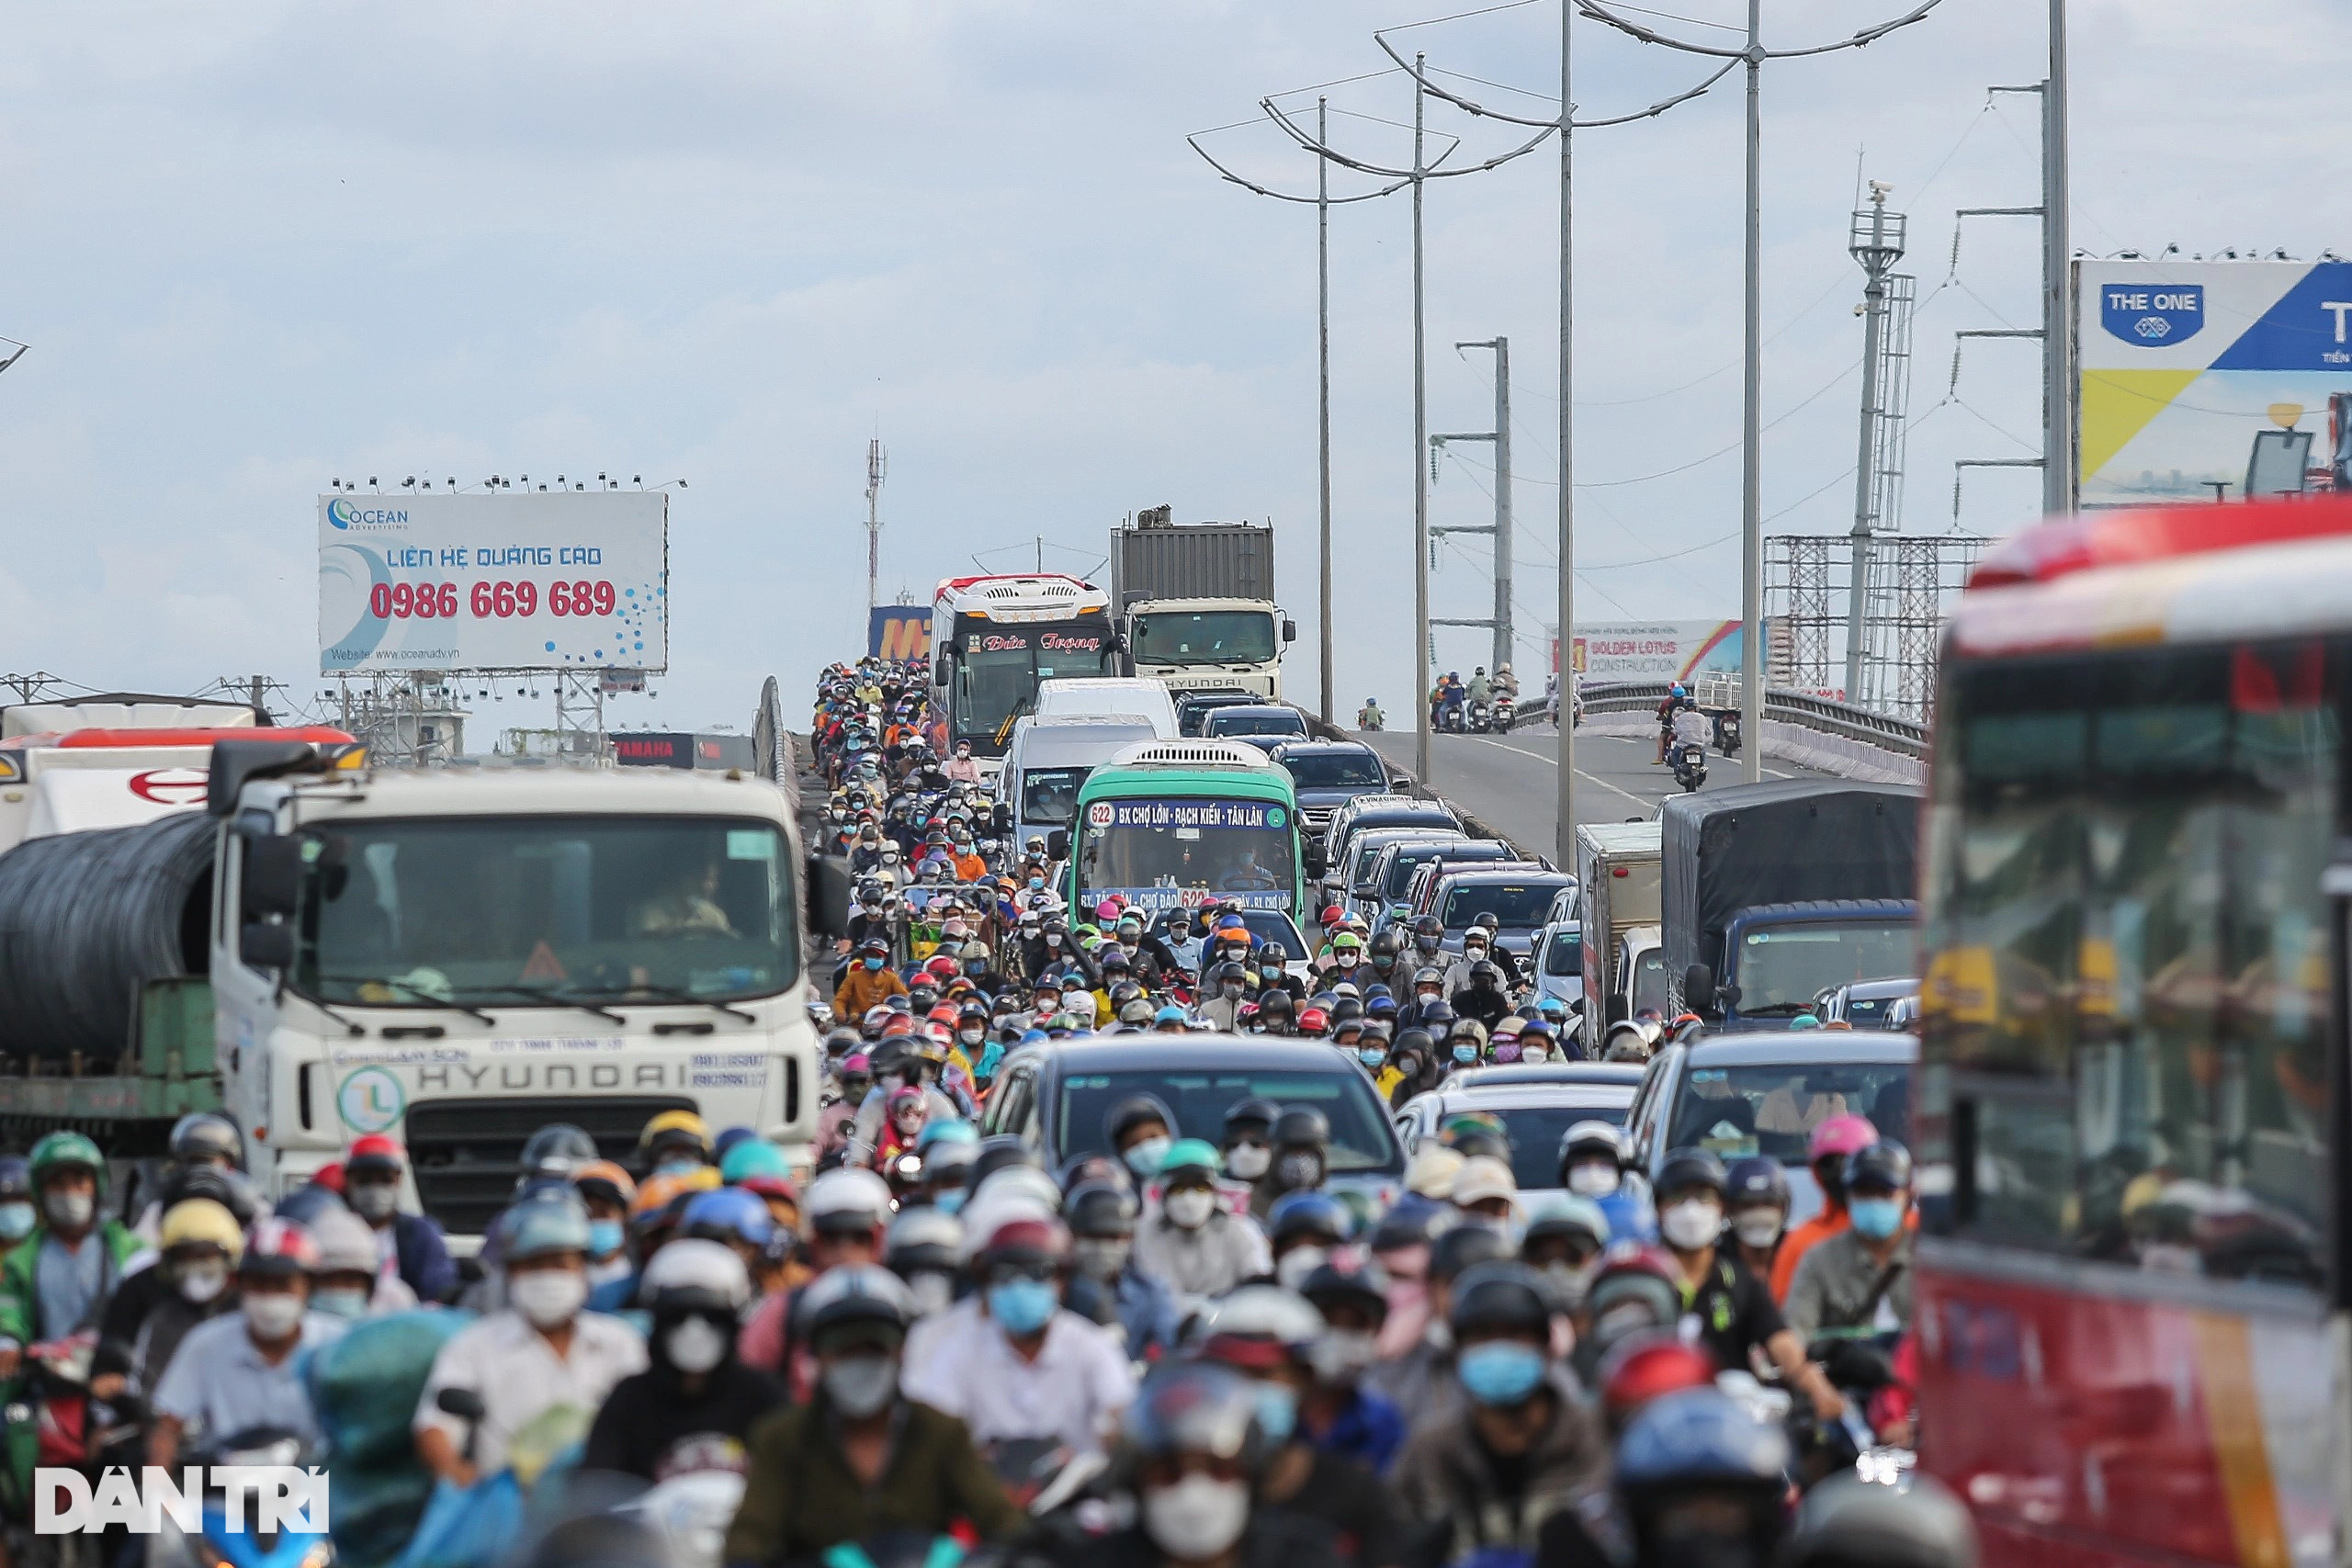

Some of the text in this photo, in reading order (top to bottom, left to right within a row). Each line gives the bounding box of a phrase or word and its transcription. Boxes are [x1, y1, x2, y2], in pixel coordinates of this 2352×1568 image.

[2109, 293, 2198, 310] THE ONE
[350, 510, 408, 525] OCEAN
[387, 544, 433, 568] LIÊN
[560, 544, 602, 566] CÁO
[370, 580, 617, 618] 0986 669 689
[1590, 640, 1678, 656] GOLDEN LOTUS
[1590, 659, 1678, 673] CONSTRUCTION
[1165, 679, 1242, 688] HYUNDAI
[1091, 806, 1111, 824] 622
[1119, 807, 1131, 824] BX
[1132, 804, 1150, 828] CHỢ
[1152, 803, 1170, 824] LỚN
[1175, 807, 1198, 828] RẠCH
[1200, 802, 1221, 825] KIẾN
[1227, 805, 1244, 826] TÂN
[1246, 806, 1263, 827] LÂN
[418, 1065, 687, 1090] HYUNDAI
